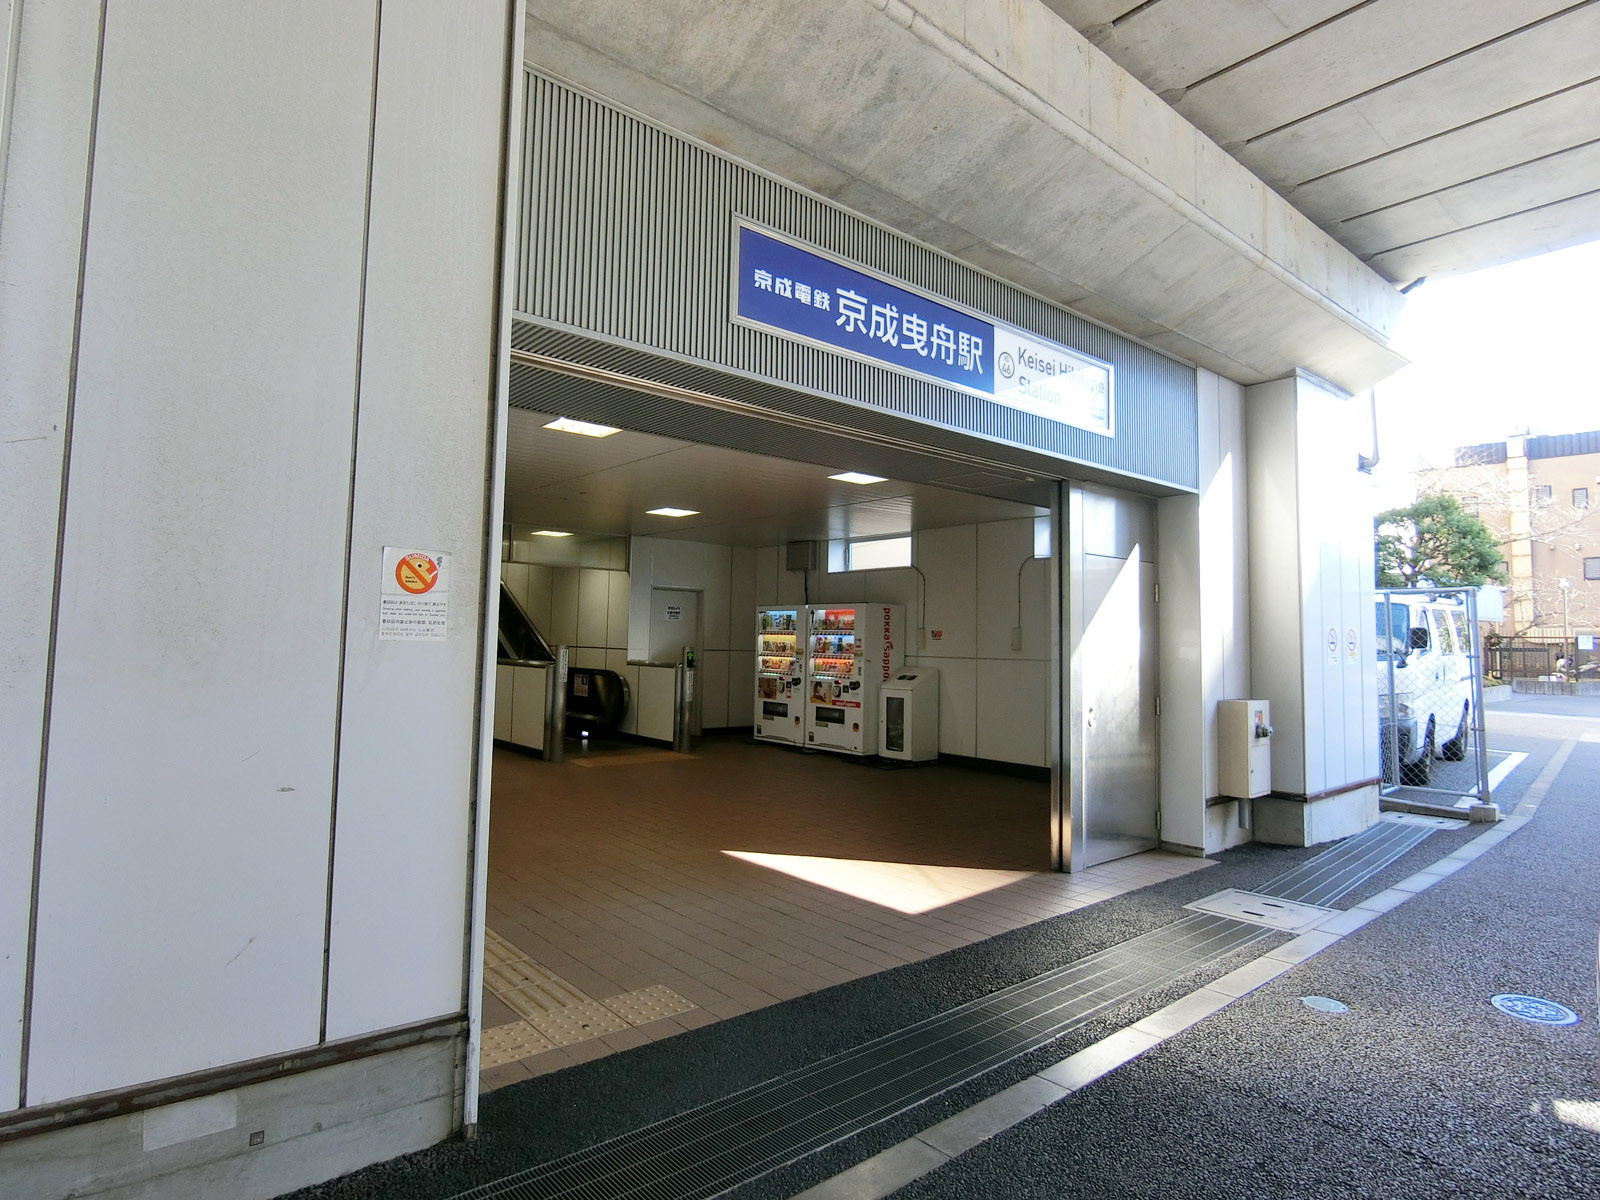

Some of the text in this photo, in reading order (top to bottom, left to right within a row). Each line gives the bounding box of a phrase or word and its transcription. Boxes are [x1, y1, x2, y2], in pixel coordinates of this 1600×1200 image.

[754, 269, 983, 375] 京成電鉄 京成曳舟駅
[1002, 363, 1011, 375] 46
[1018, 346, 1055, 376] Keisei
[882, 646, 890, 682] sappo
